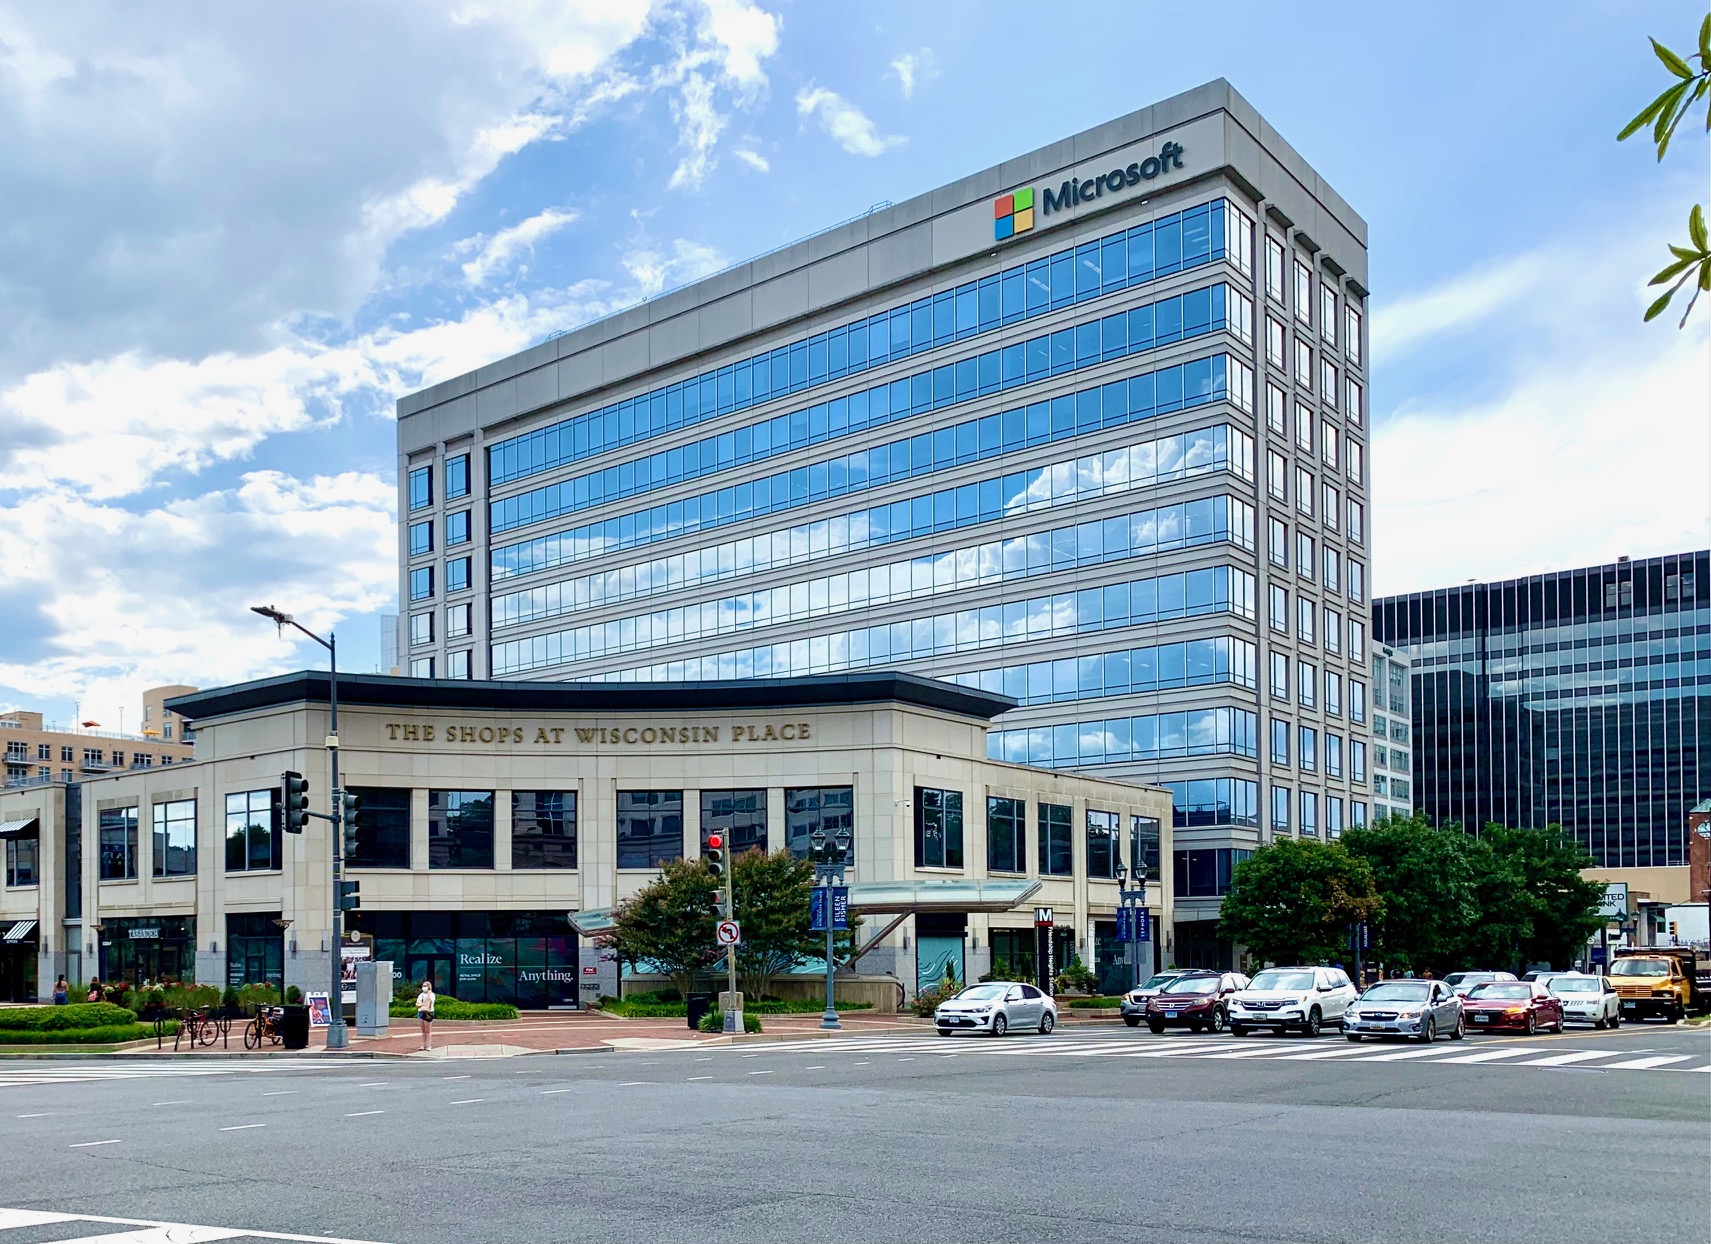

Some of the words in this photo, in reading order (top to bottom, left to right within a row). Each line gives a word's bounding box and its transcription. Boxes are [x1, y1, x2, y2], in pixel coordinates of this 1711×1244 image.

[1043, 141, 1184, 216] Microsoft
[386, 723, 435, 742] THE
[446, 725, 524, 744] SHOPS
[534, 727, 564, 744] AT
[575, 726, 719, 744] WISCONSIN
[732, 723, 811, 742] PLACE
[1603, 893, 1625, 901] ITED
[1039, 908, 1053, 922] M
[460, 953, 503, 965] Realize
[519, 969, 574, 984] Anything.
